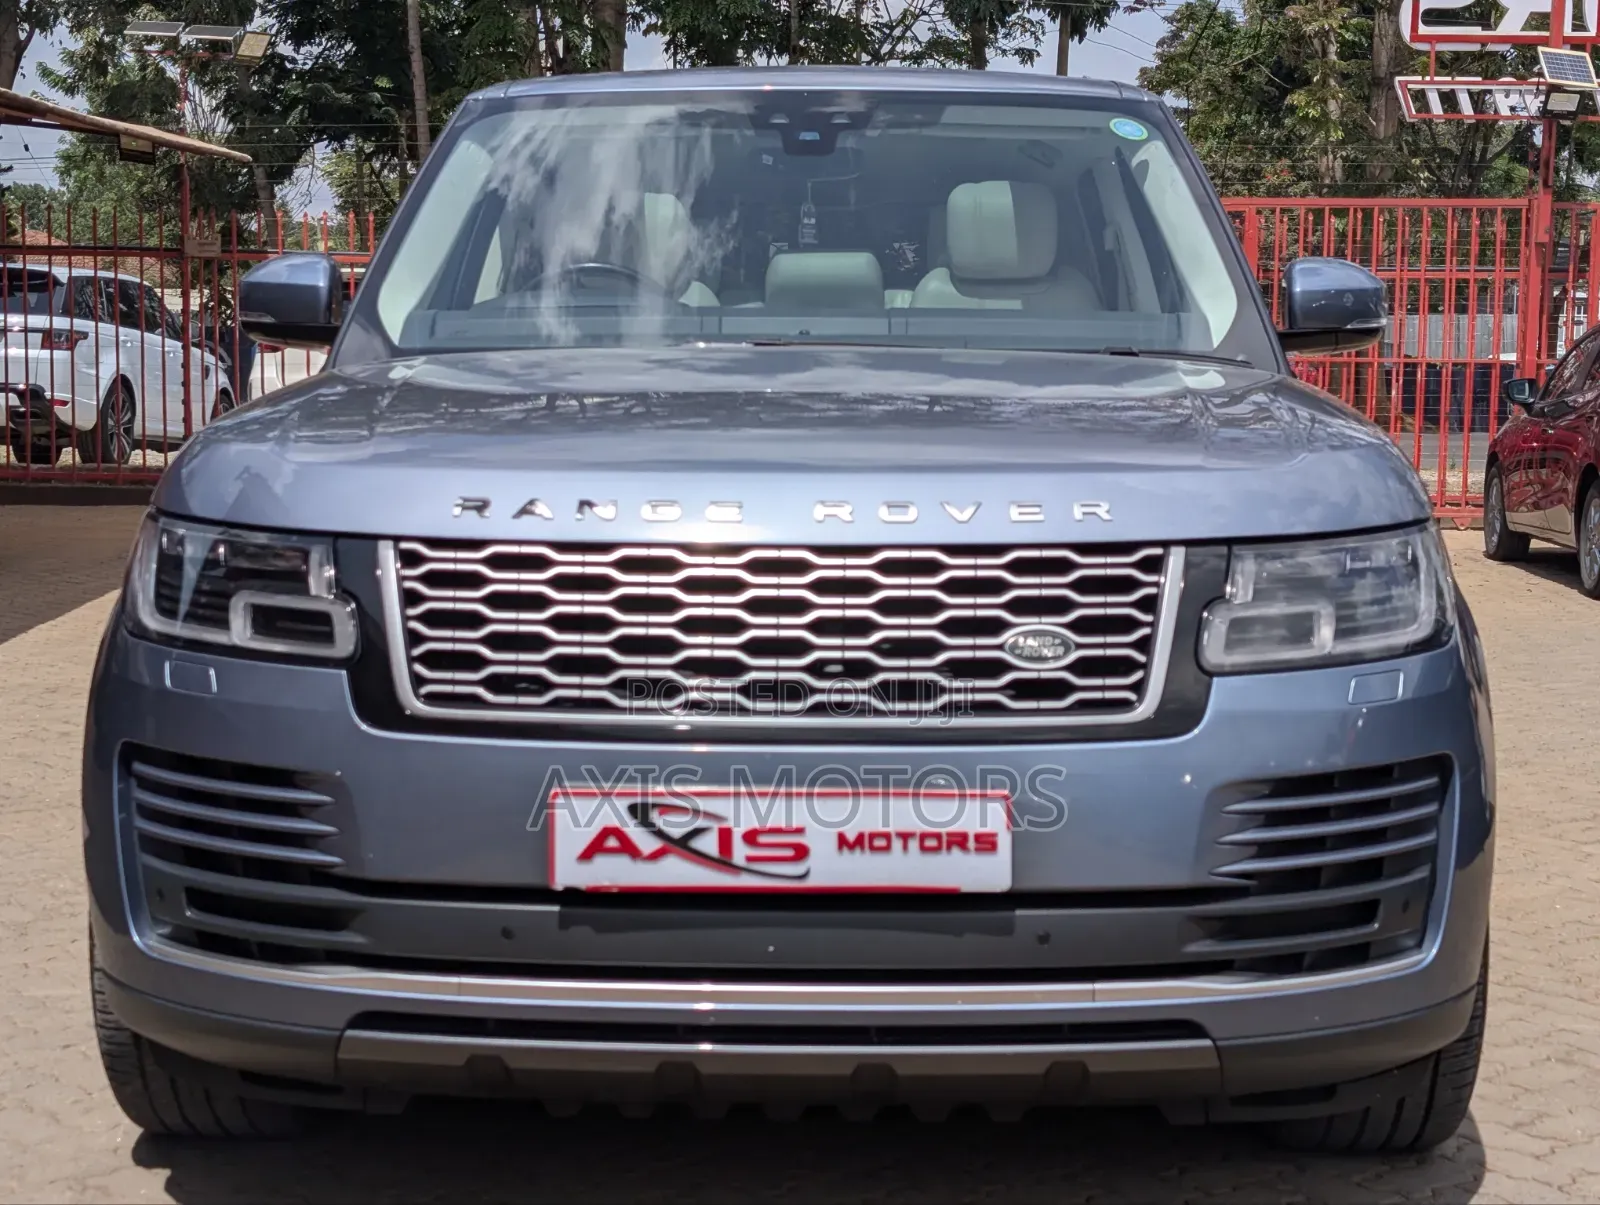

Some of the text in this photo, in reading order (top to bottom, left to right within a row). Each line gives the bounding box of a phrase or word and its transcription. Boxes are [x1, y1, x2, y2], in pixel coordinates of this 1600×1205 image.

[452, 496, 1113, 524] RANGE ROVER
[576, 802, 999, 880] AXIS MOTORS
